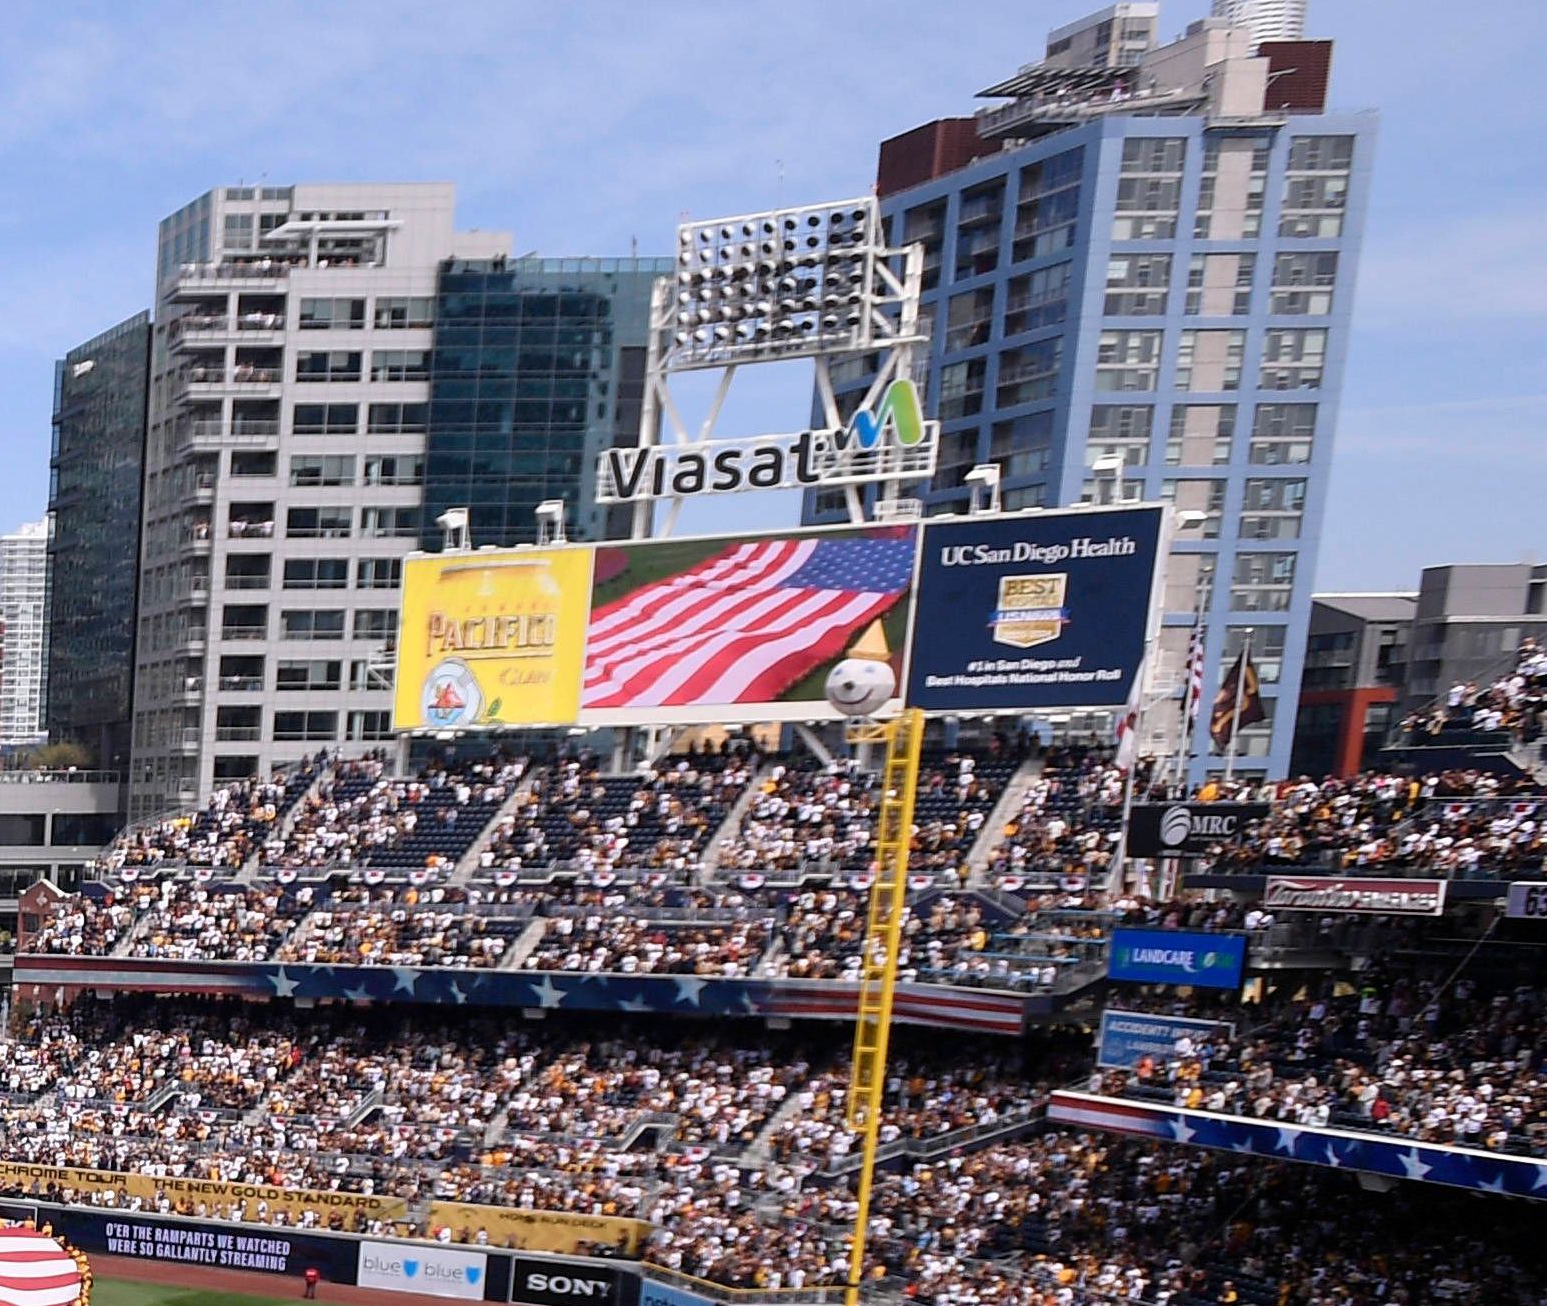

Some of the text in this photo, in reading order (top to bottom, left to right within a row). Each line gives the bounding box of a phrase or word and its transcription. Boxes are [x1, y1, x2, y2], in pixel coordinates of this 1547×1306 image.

[608, 433, 819, 499] Viasat
[941, 536, 1136, 567] UC San Diego Health
[1004, 578, 1062, 597] BEST
[997, 659, 1019, 671] San
[1021, 658, 1055, 672] Diego
[955, 673, 1008, 687] Hospitals
[1009, 671, 1057, 685] National
[1191, 814, 1237, 836] MRC
[76, 1171, 127, 1185] TOUR
[152, 1178, 382, 1209] THE NEW GOLD STANDARD
[131, 1224, 152, 1240] THE
[155, 1227, 214, 1248] RAMPARTS
[217, 1234, 234, 1249] WE
[237, 1236, 291, 1256] WATCHED
[108, 1238, 286, 1271] WERE SO GALLANTLY STREAMING
[363, 1255, 401, 1273] blue
[424, 1261, 464, 1279] blue
[527, 1273, 612, 1298] SONY
